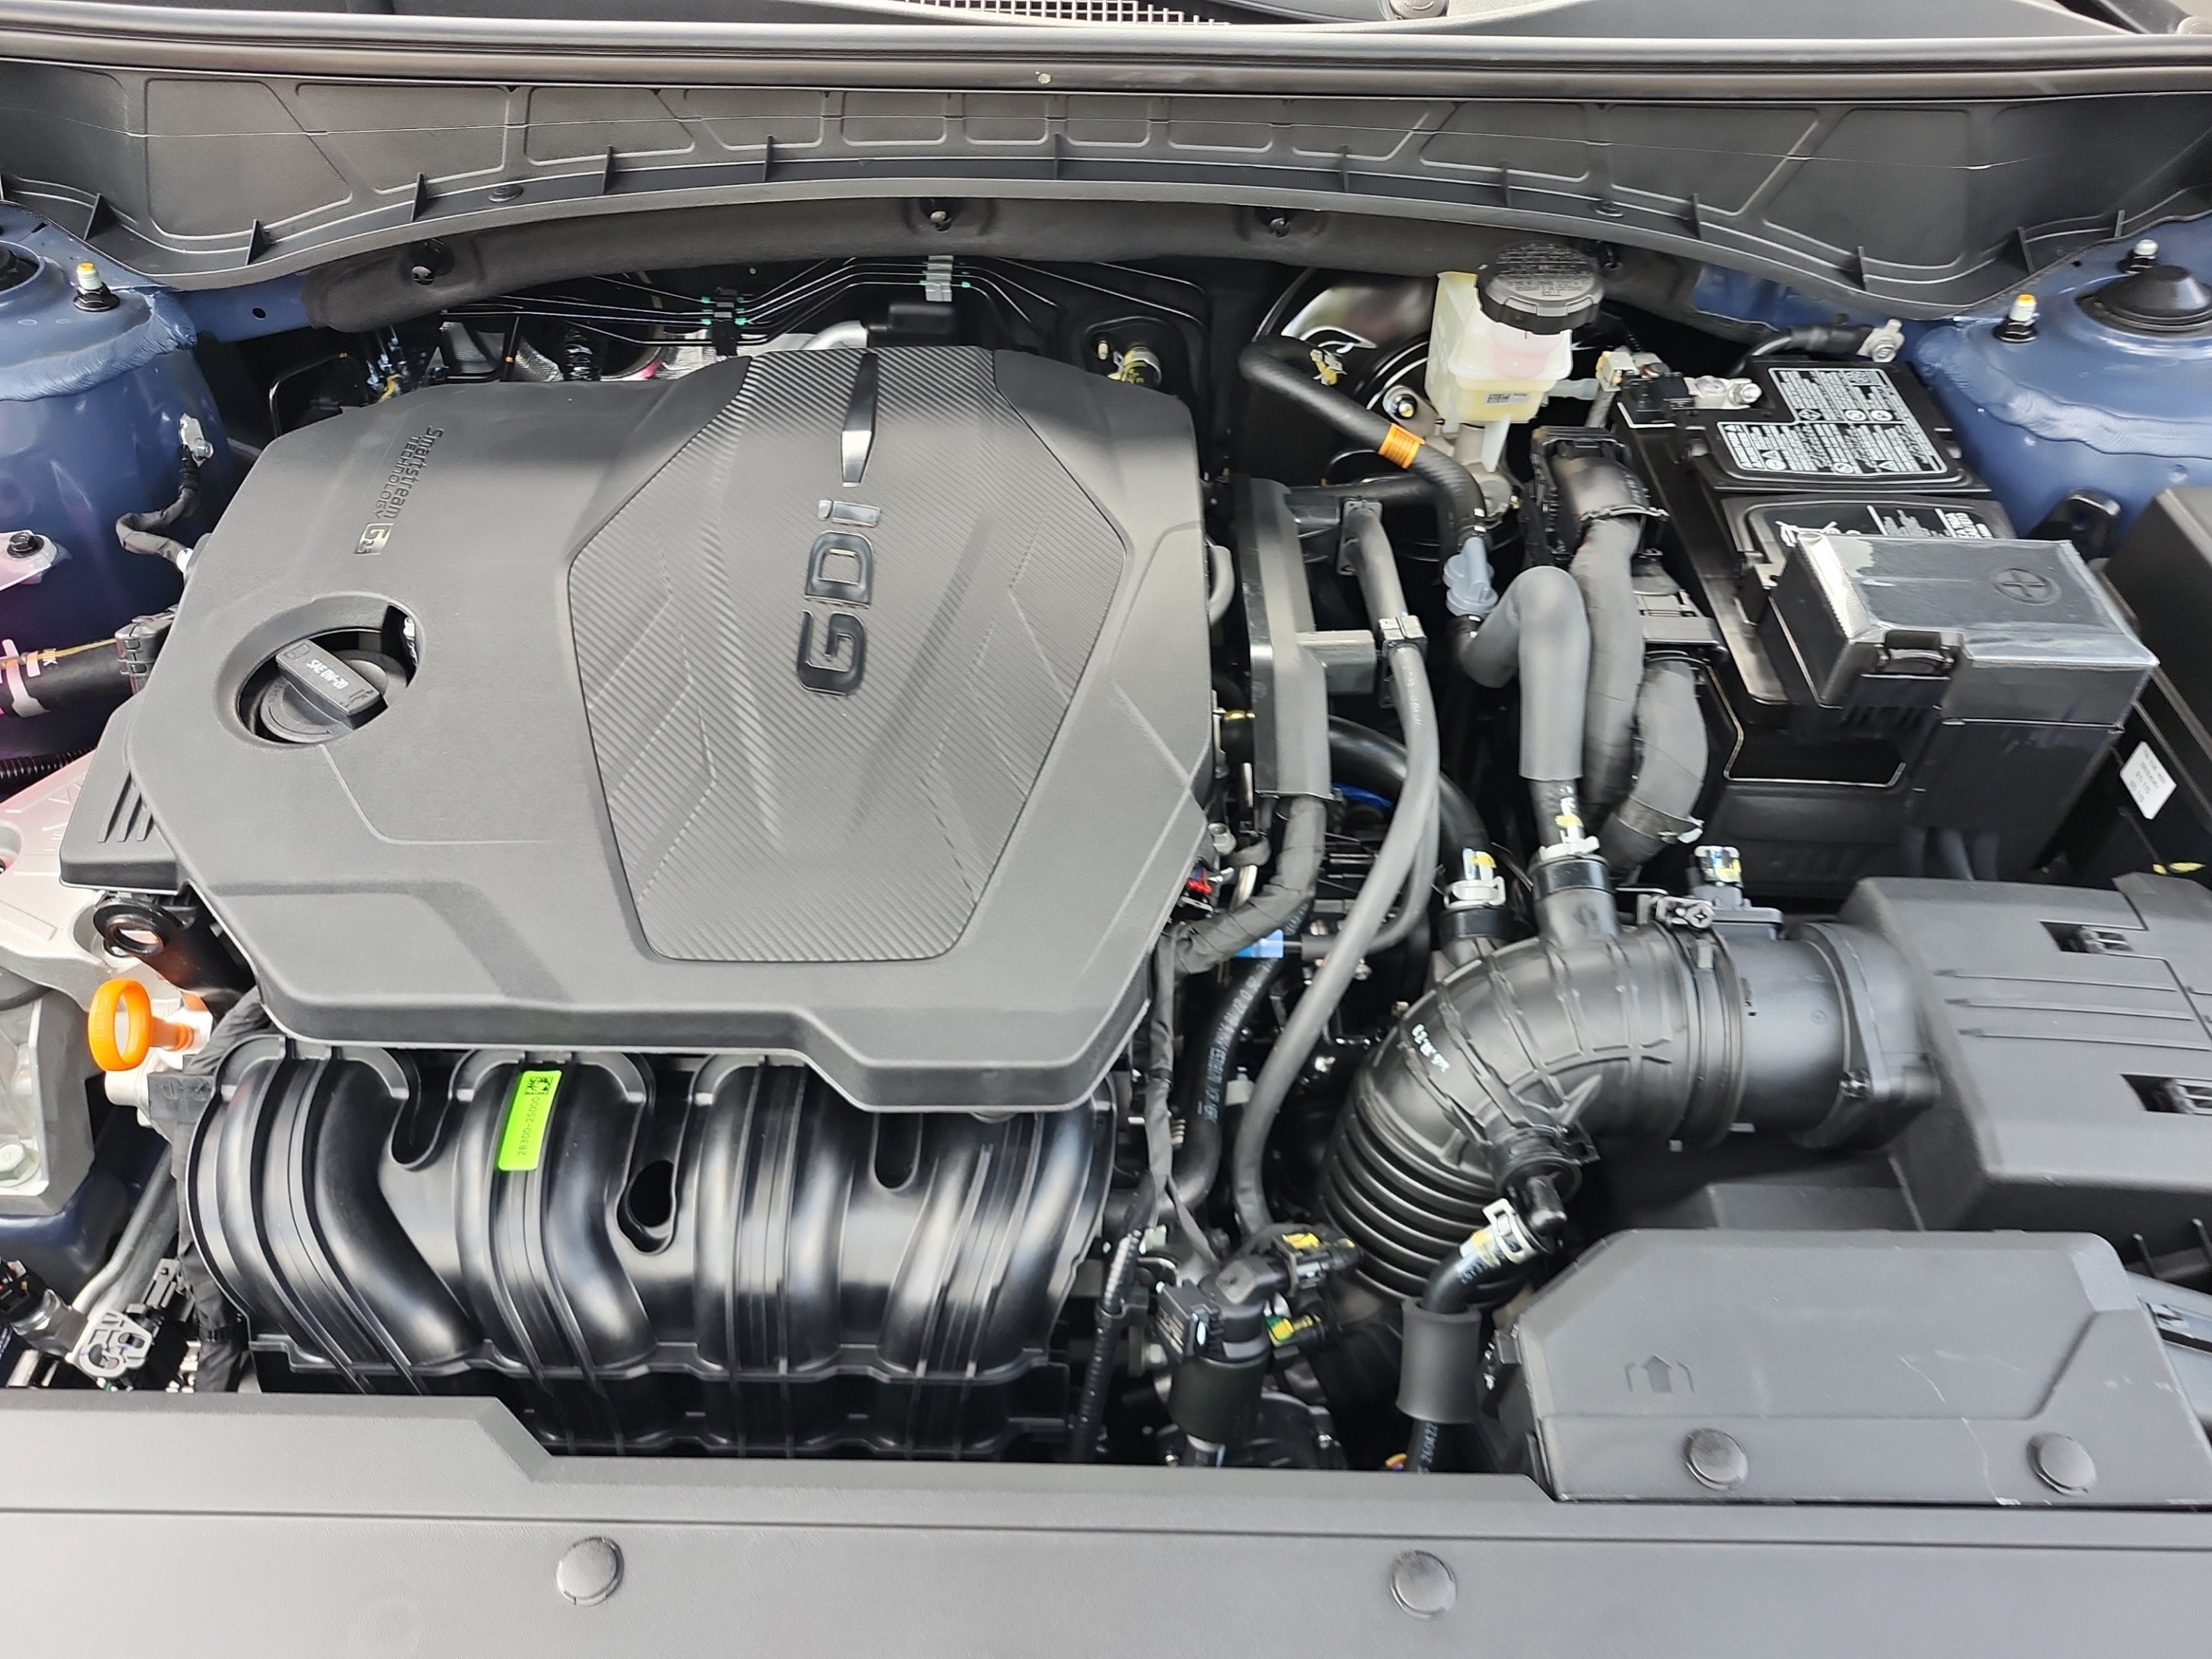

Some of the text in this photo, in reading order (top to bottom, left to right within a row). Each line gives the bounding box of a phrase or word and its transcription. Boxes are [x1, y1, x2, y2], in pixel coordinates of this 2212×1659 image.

[373, 435, 421, 519] TECHNOLOGY
[383, 426, 445, 519] Smartstream
[796, 498, 881, 696] GDi
[306, 659, 349, 690] SAE 0W-20
